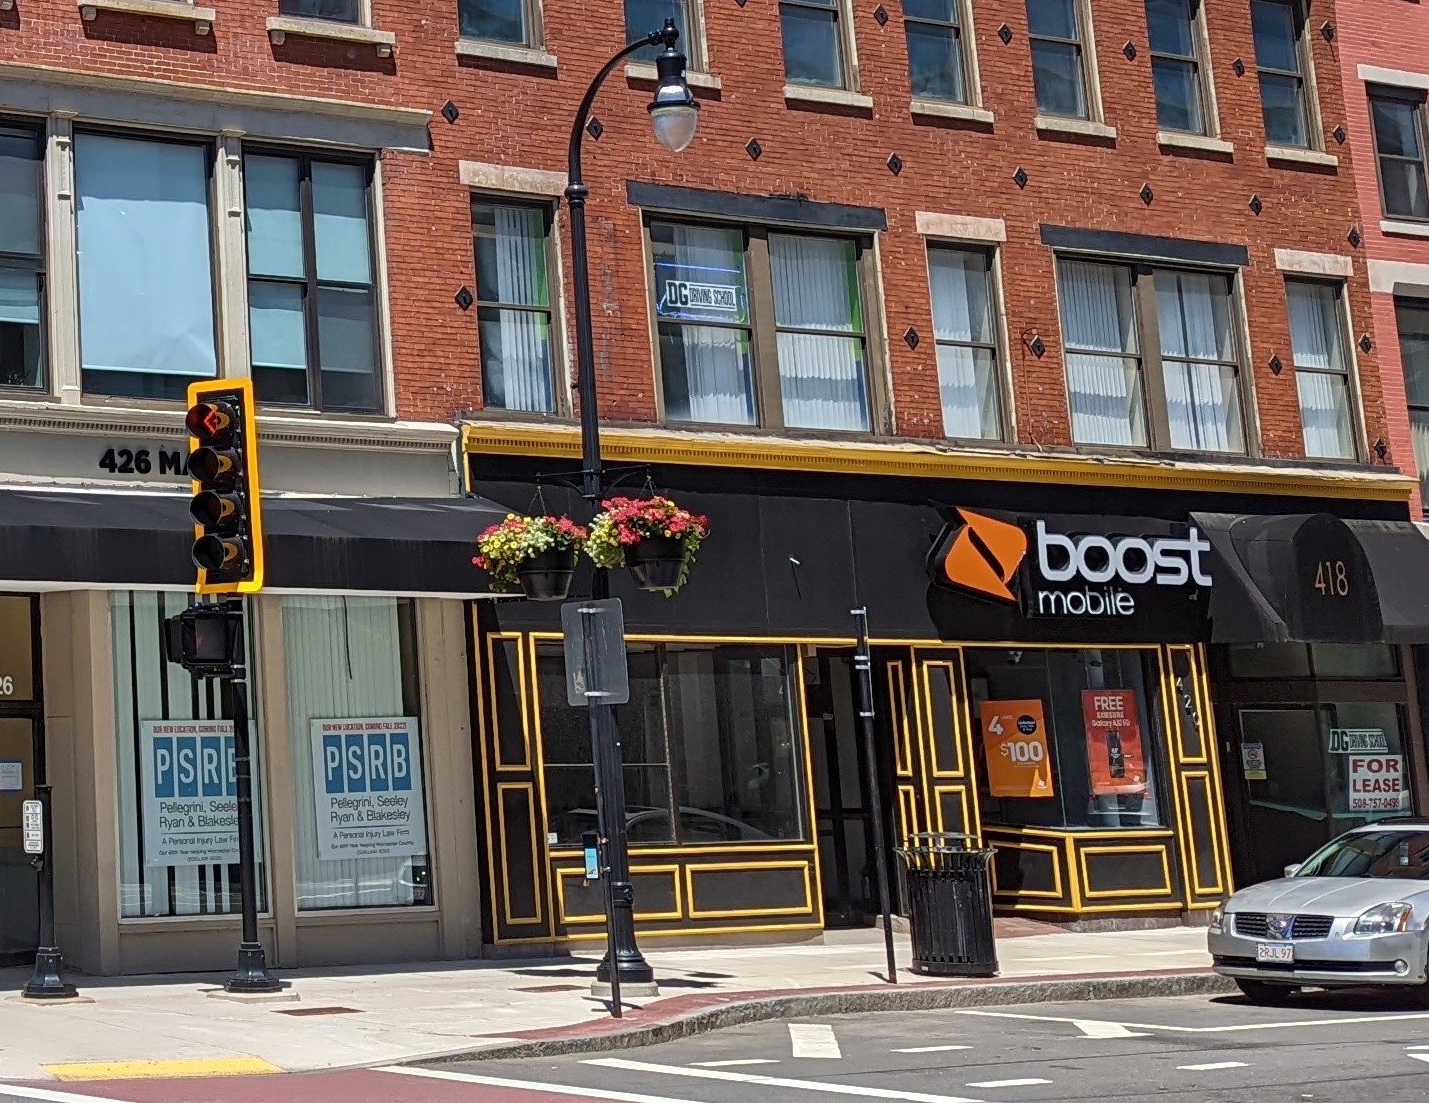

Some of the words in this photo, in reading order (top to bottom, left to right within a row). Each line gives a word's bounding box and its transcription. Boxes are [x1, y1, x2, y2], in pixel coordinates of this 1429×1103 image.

[667, 282, 689, 306] DG
[713, 289, 736, 307] SCHOOL
[99, 449, 152, 475] 426
[1036, 519, 1213, 587] boost
[1314, 560, 1349, 596] 418
[1038, 584, 1135, 616] mobile
[1093, 696, 1125, 711] FREE
[988, 715, 1004, 735] 4
[1091, 719, 1112, 729] Galaxy
[1330, 730, 1350, 752] DG
[1000, 741, 1044, 762] $100
[326, 744, 407, 781] PSRB
[1352, 759, 1399, 773] FOR
[1352, 778, 1400, 793] LEASE
[160, 800, 206, 815] Pellegrini,
[210, 800, 238, 812] Seele
[331, 796, 374, 810] Pellegrini,
[377, 795, 408, 808] Seeley
[159, 816, 184, 830] Ryan
[187, 816, 195, 827] &
[198, 815, 239, 827] Blakesle
[330, 811, 354, 825] Ryan
[357, 810, 364, 821] &
[366, 809, 410, 822] Blakesley
[162, 837, 167, 845] A
[169, 836, 195, 845] Personal
[197, 836, 213, 846] Injury
[215, 836, 228, 844] Law
[333, 831, 338, 839] A
[340, 831, 364, 839] Personal
[366, 830, 382, 840] Injury
[383, 829, 395, 837] Law
[397, 828, 409, 836] Firm
[1281, 948, 1292, 959] 97
